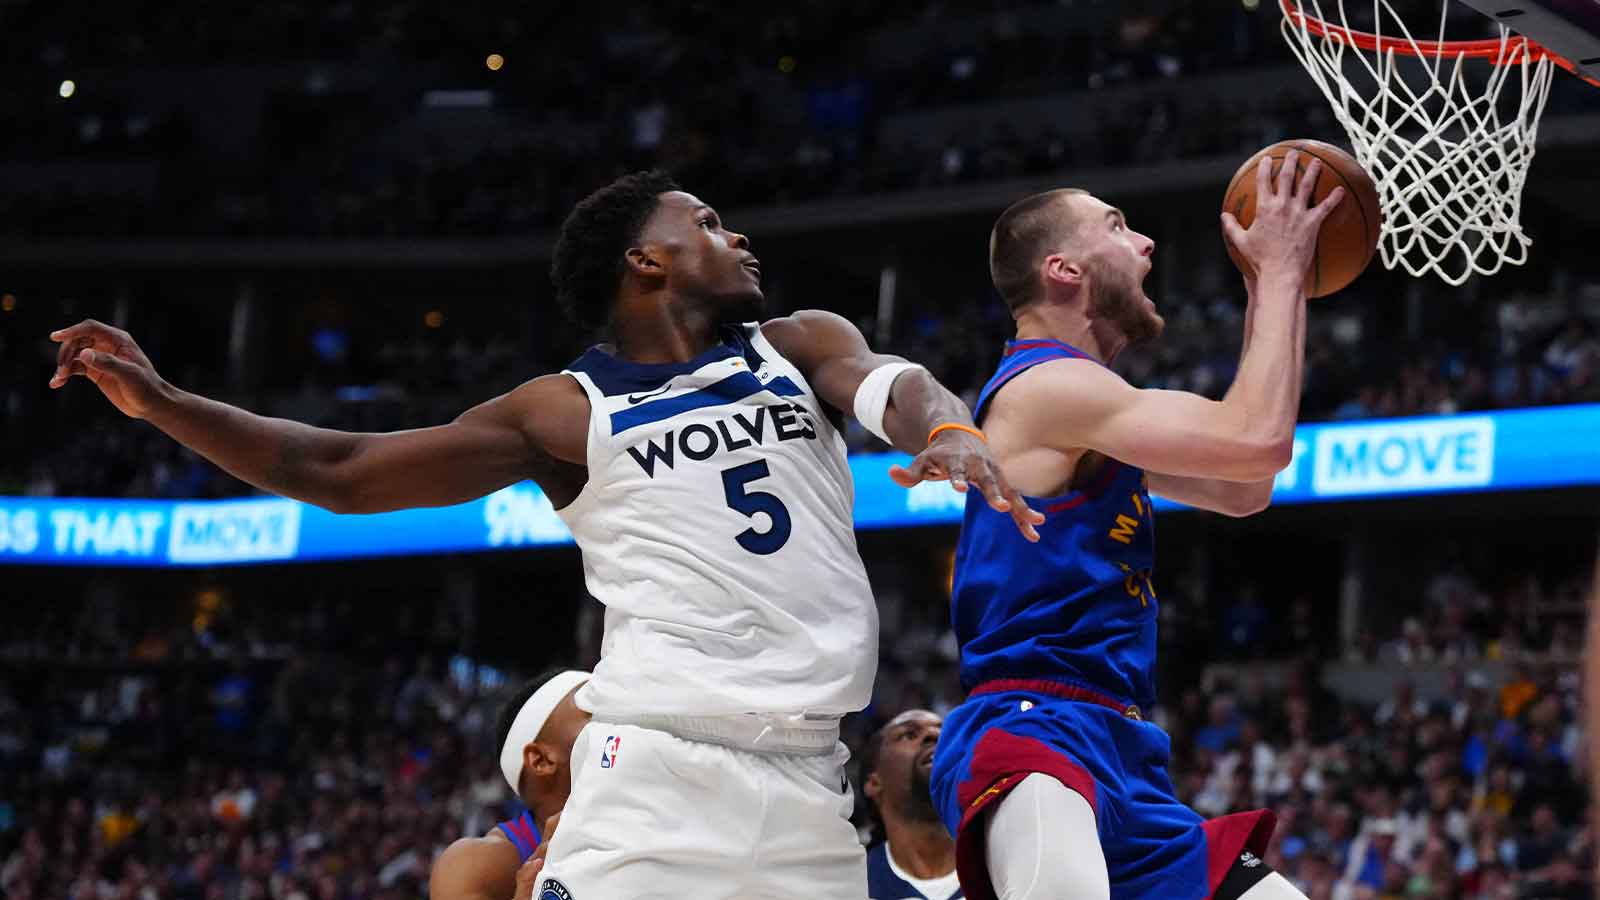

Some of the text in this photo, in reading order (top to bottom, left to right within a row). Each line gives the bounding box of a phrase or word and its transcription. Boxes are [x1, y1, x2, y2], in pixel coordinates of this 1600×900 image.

[626, 402, 817, 479] WOLVES
[1329, 431, 1477, 479] MOVE
[51, 509, 164, 555] THAT
[720, 458, 792, 556] 5
